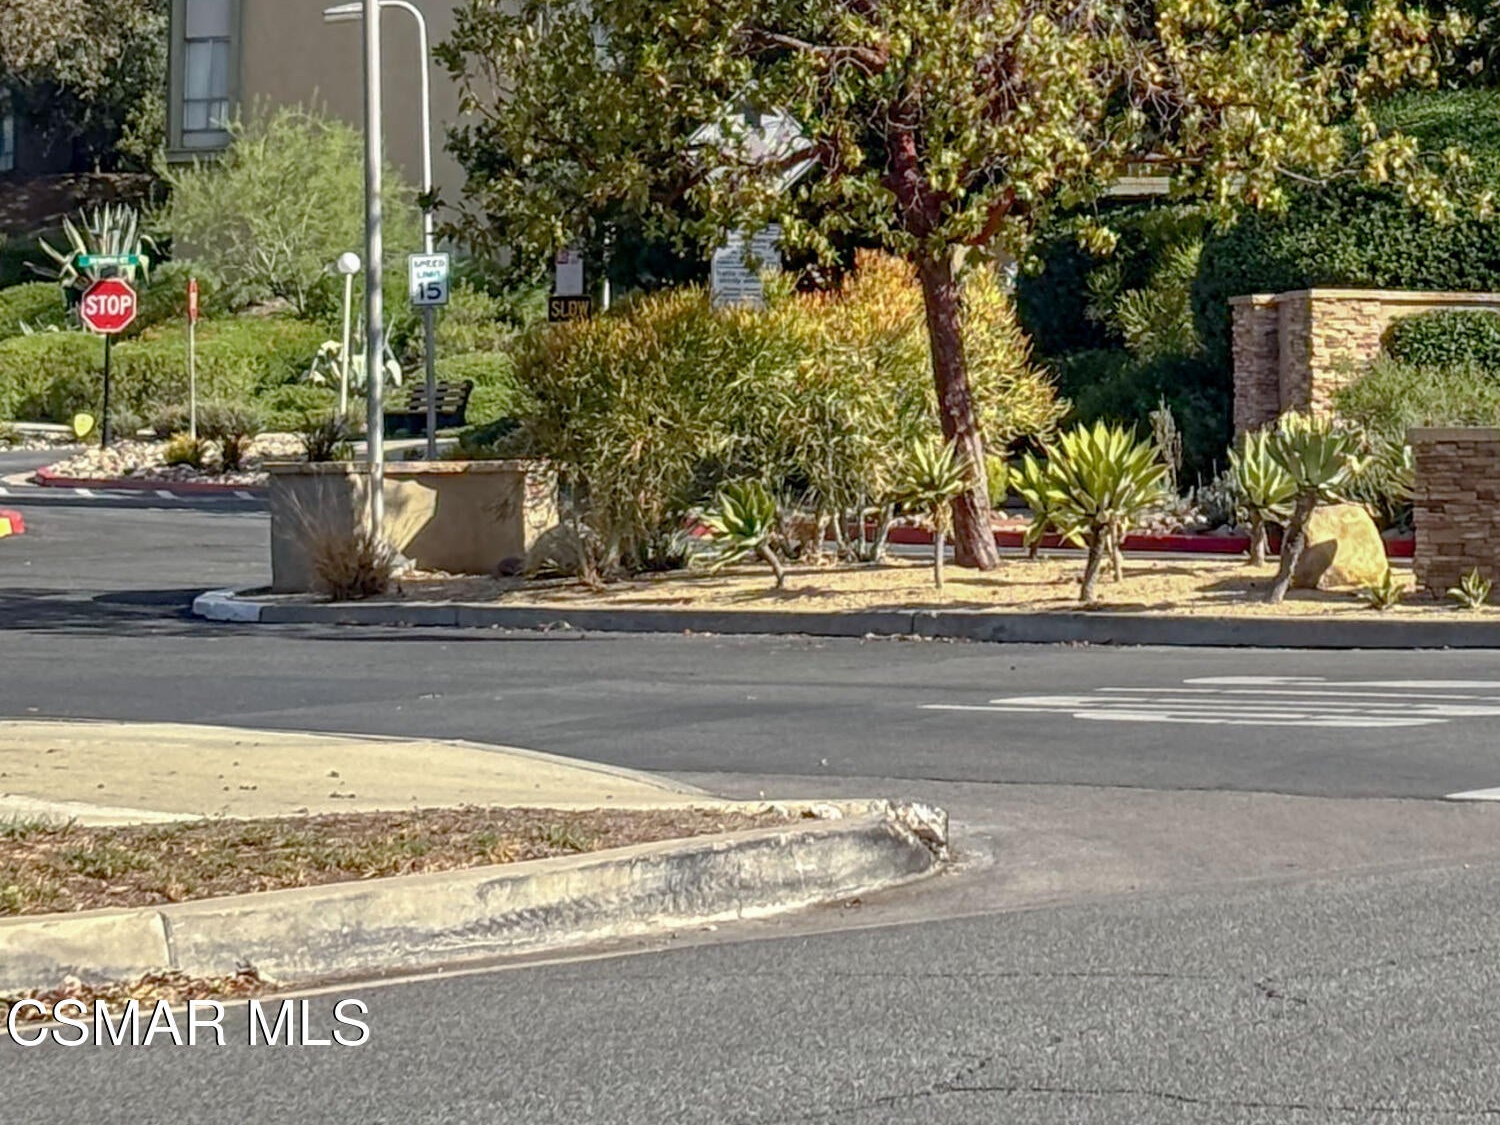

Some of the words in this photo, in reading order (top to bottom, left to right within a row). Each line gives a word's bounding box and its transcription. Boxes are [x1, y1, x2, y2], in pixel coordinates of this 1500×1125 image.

[418, 281, 442, 301] 15
[86, 294, 132, 316] STOP
[551, 300, 590, 318] SLOW
